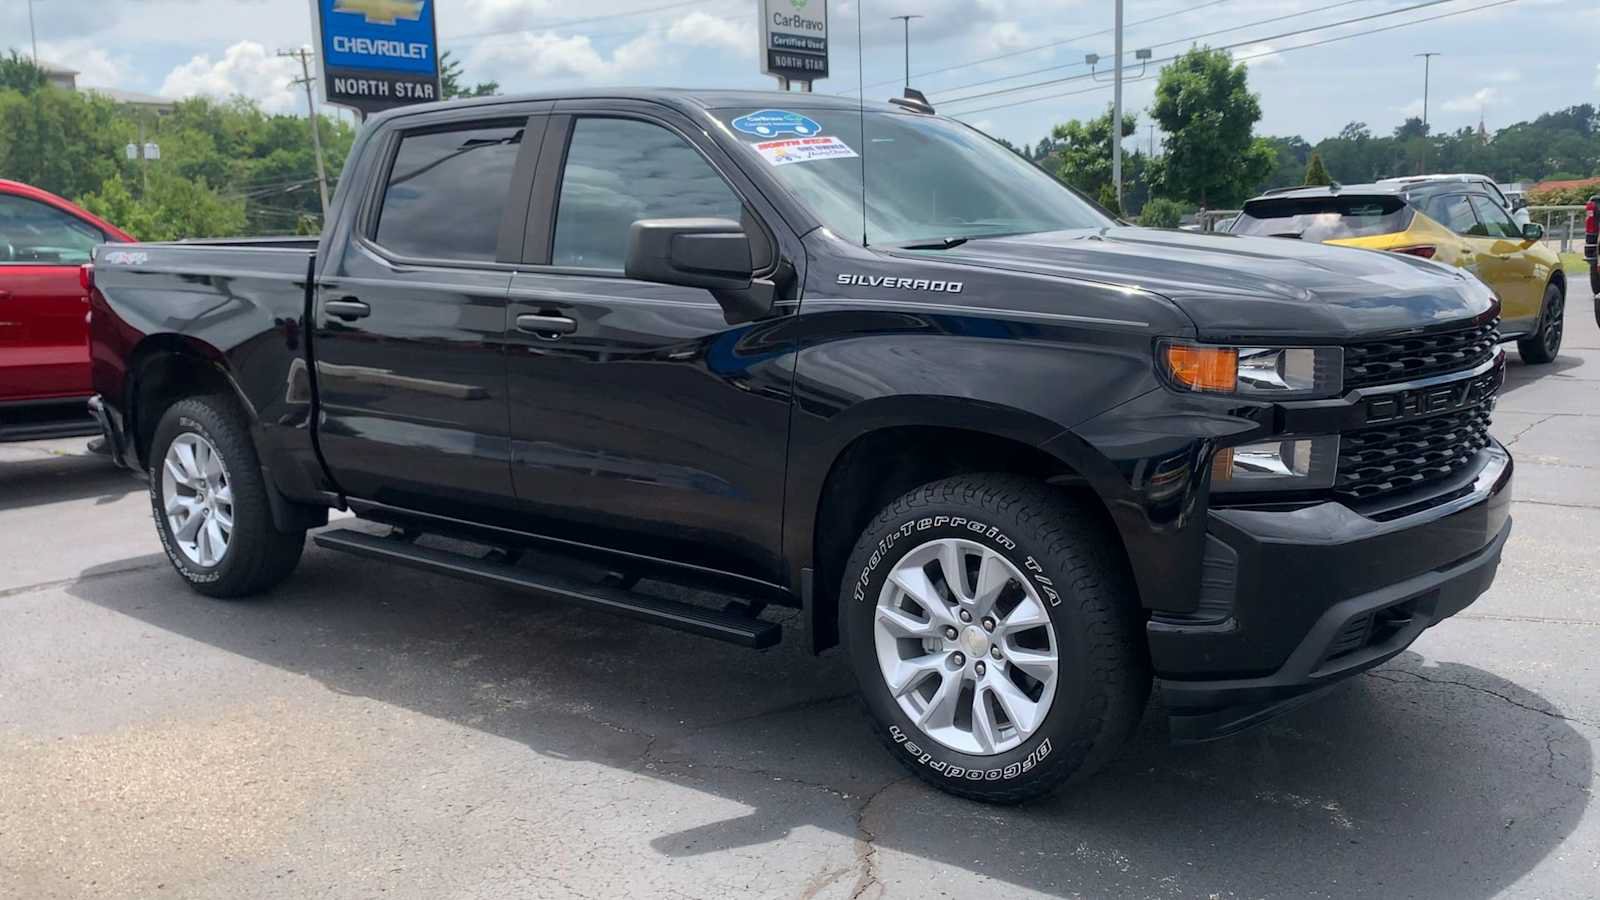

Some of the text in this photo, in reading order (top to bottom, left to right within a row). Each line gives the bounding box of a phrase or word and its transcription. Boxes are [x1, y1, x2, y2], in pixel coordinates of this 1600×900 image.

[773, 12, 824, 31] CarBravo
[333, 36, 429, 59] CHEVROLET
[775, 55, 824, 70] NORTH STAR
[334, 78, 434, 99] NORTH STAR
[836, 273, 963, 293] SILVERADO
[1024, 555, 1063, 607] T/A
[889, 725, 1052, 780] BFGoodrich
